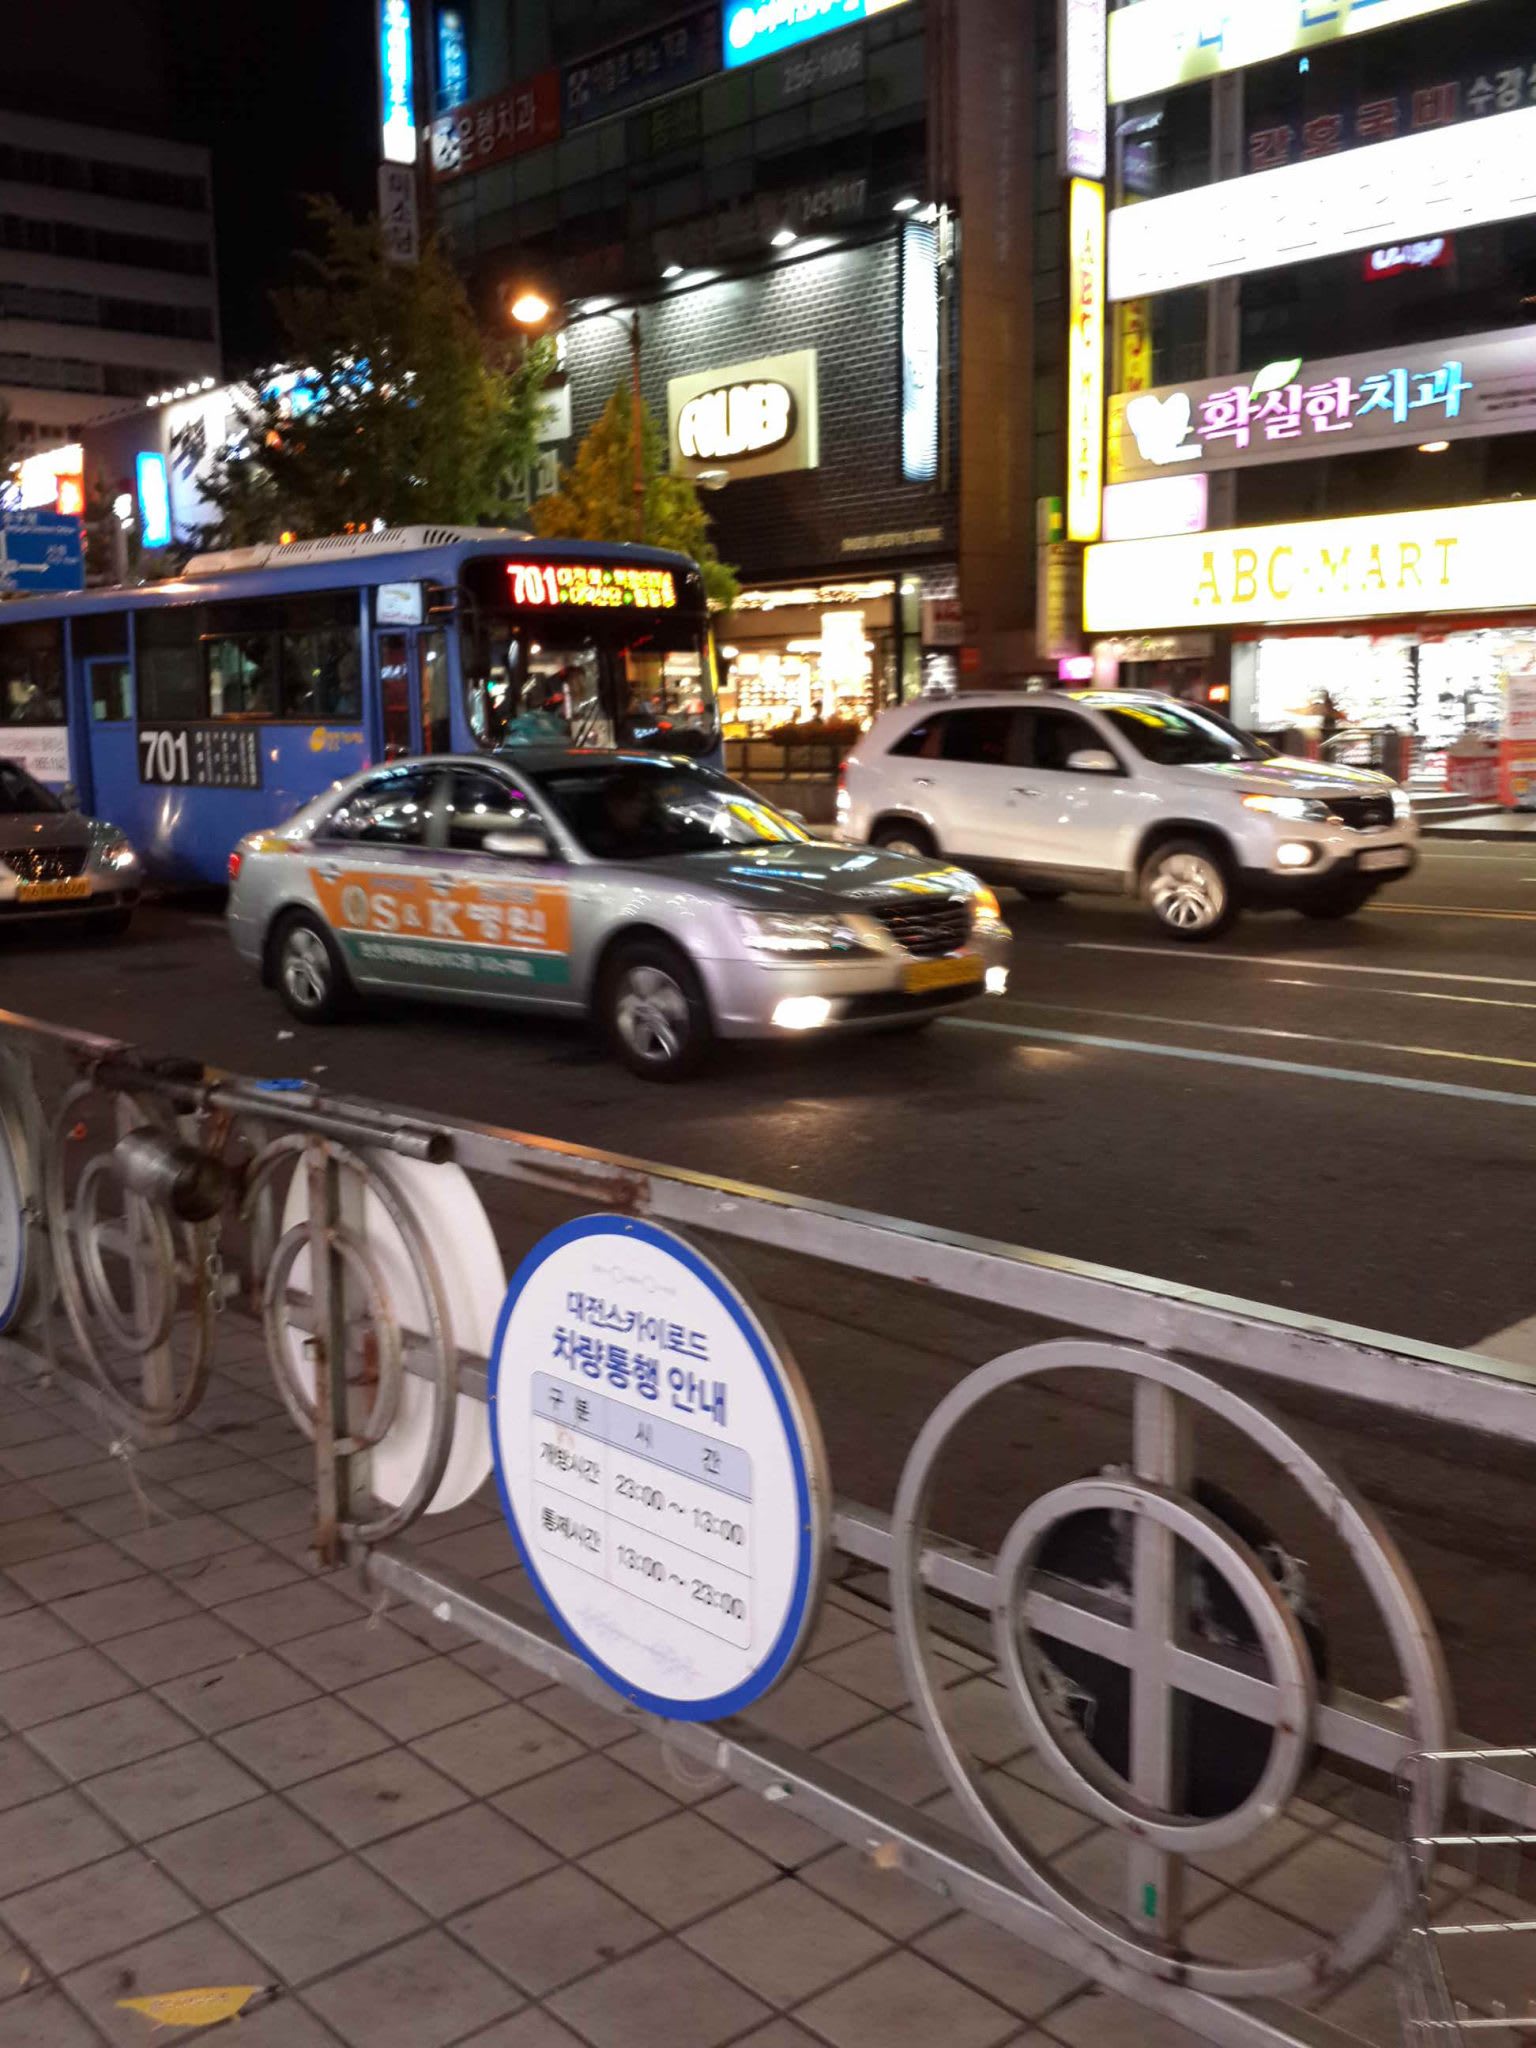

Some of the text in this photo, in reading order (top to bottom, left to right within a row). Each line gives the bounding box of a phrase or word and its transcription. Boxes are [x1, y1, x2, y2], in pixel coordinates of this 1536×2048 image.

[507, 564, 559, 605] 701
[139, 731, 190, 782] 701
[566, 1291, 711, 1362] 대전스카이로드
[552, 1325, 727, 1427] 차량통행 안내
[615, 1474, 666, 1511] 23:00
[692, 1507, 745, 1546] 13:00
[541, 1506, 601, 1554] 통제시간
[617, 1544, 666, 1583] 13:00
[691, 1578, 745, 1621] 23:00
